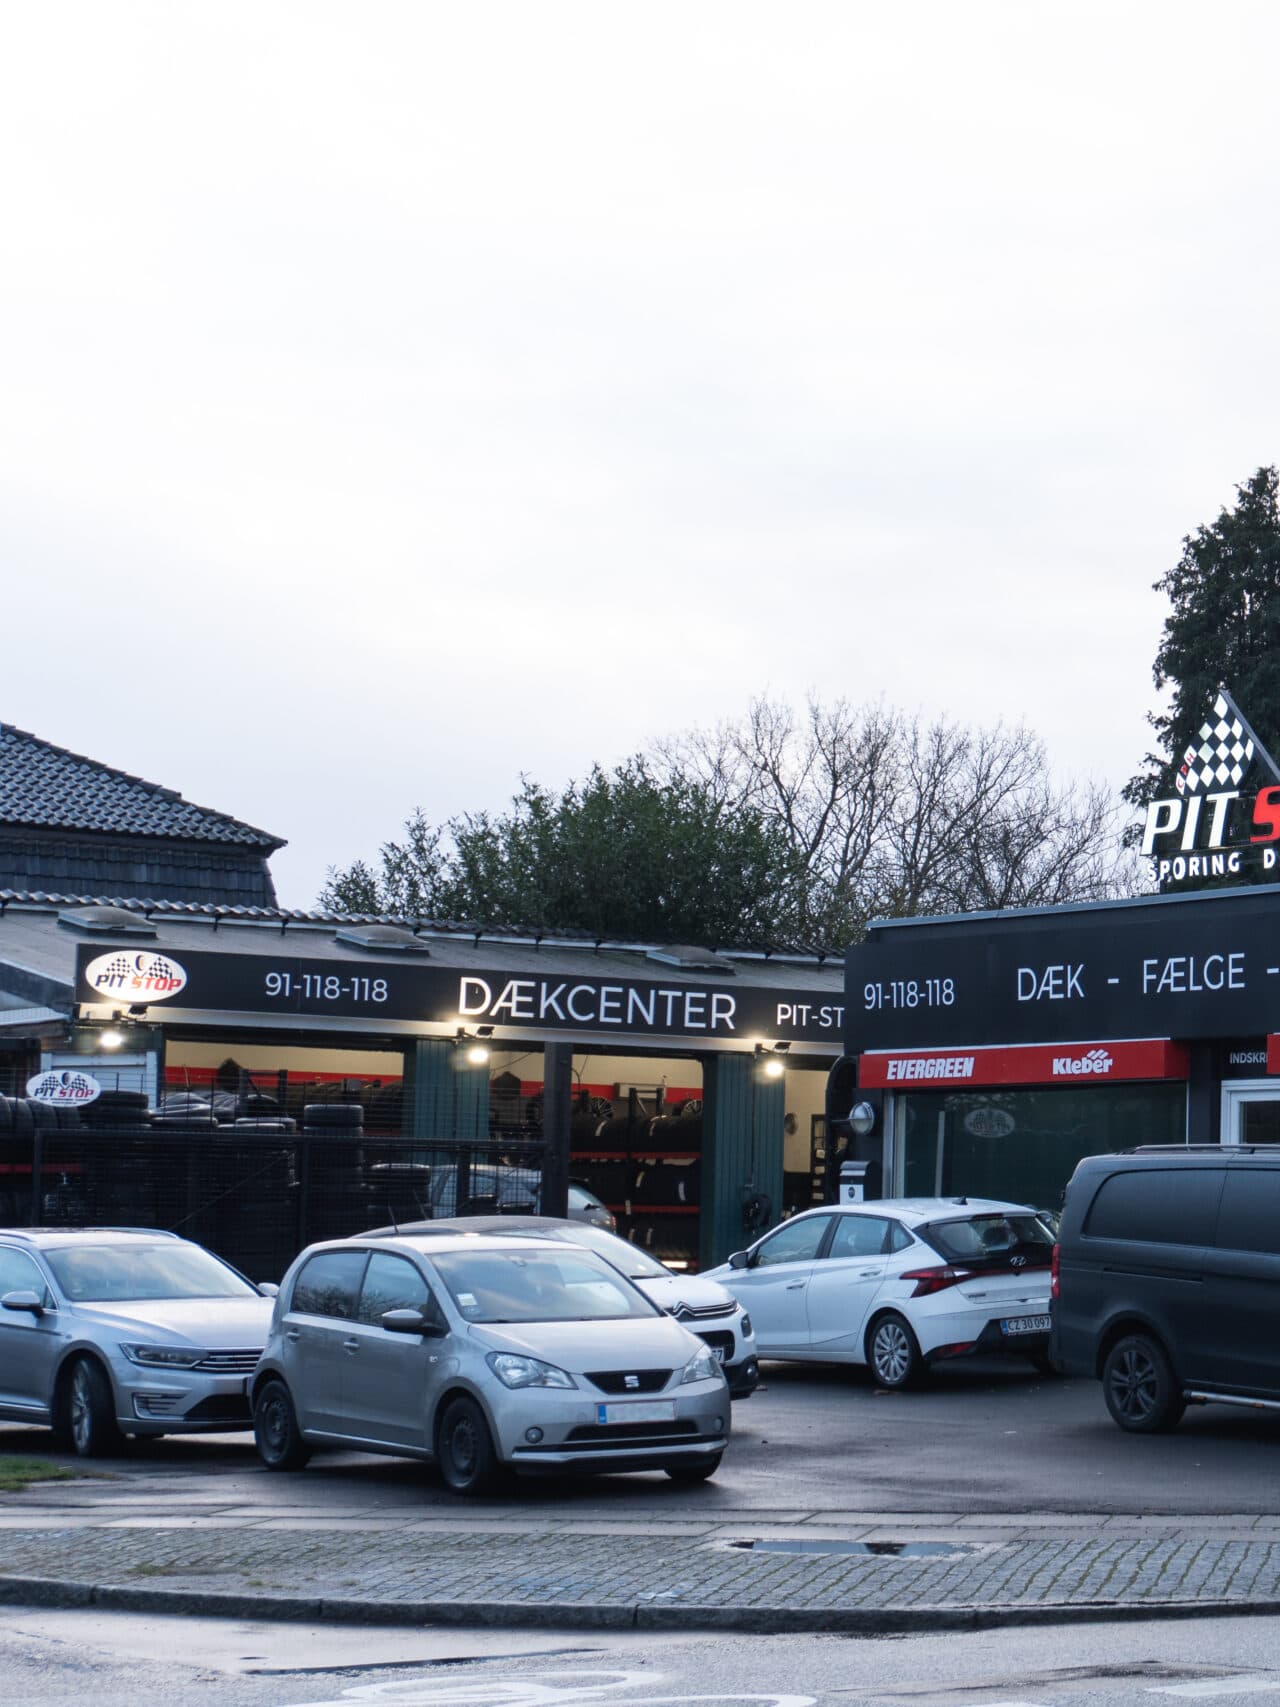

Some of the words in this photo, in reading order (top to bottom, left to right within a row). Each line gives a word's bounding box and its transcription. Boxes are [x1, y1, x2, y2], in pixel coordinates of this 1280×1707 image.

[1140, 791, 1239, 856] PIT
[1149, 852, 1240, 881] SPORING
[95, 973, 128, 989] PIT
[130, 976, 183, 992] STOP
[265, 972, 388, 1002] 91-118-118
[1017, 964, 1085, 1001] DÆK
[1143, 953, 1246, 994] FÆLGE
[458, 976, 736, 1030] DÆKCENTER
[864, 979, 955, 1009] 91-118-118
[887, 1057, 975, 1080] EVERGREEN
[1052, 1054, 1113, 1075] Kleber
[34, 1088, 56, 1096] PIT
[58, 1088, 94, 1098] STOP
